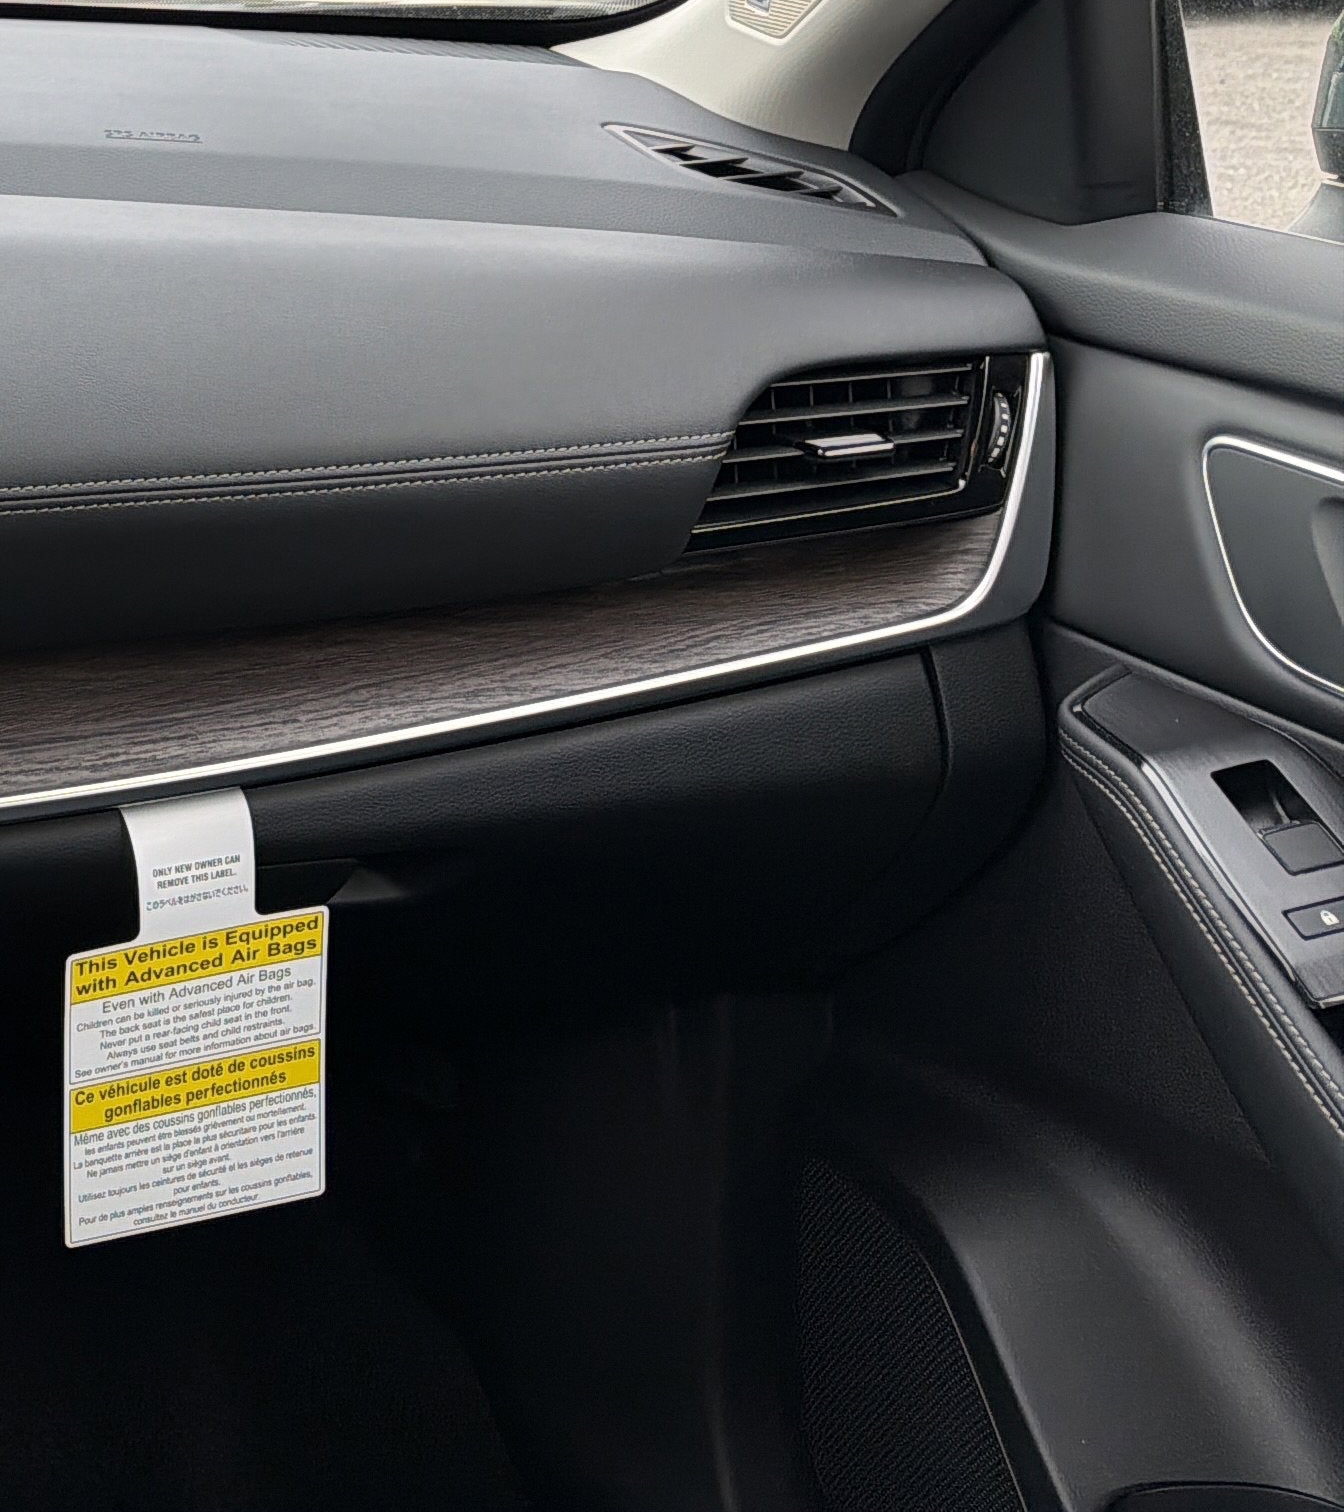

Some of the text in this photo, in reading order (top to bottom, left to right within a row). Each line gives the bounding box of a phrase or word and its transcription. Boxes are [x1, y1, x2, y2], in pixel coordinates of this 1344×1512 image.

[151, 854, 241, 878] ONLY NEW OWNER CAN
[156, 867, 238, 890] REMOVE THIS LABEL.
[74, 915, 319, 977] This Vehicle is Equipped
[75, 939, 317, 995] with Advanced Air Bags
[75, 978, 316, 1032] Children can be killed or seriously injured by the air bag.
[101, 967, 291, 1013] Even with Advanced Air Bags
[74, 1047, 319, 1105] Ce véhicule est doté de coussins
[103, 1072, 287, 1122] gonflables perfectionnés
[73, 1087, 317, 1146] Même avec des coussins gonflables perfectionnés,
